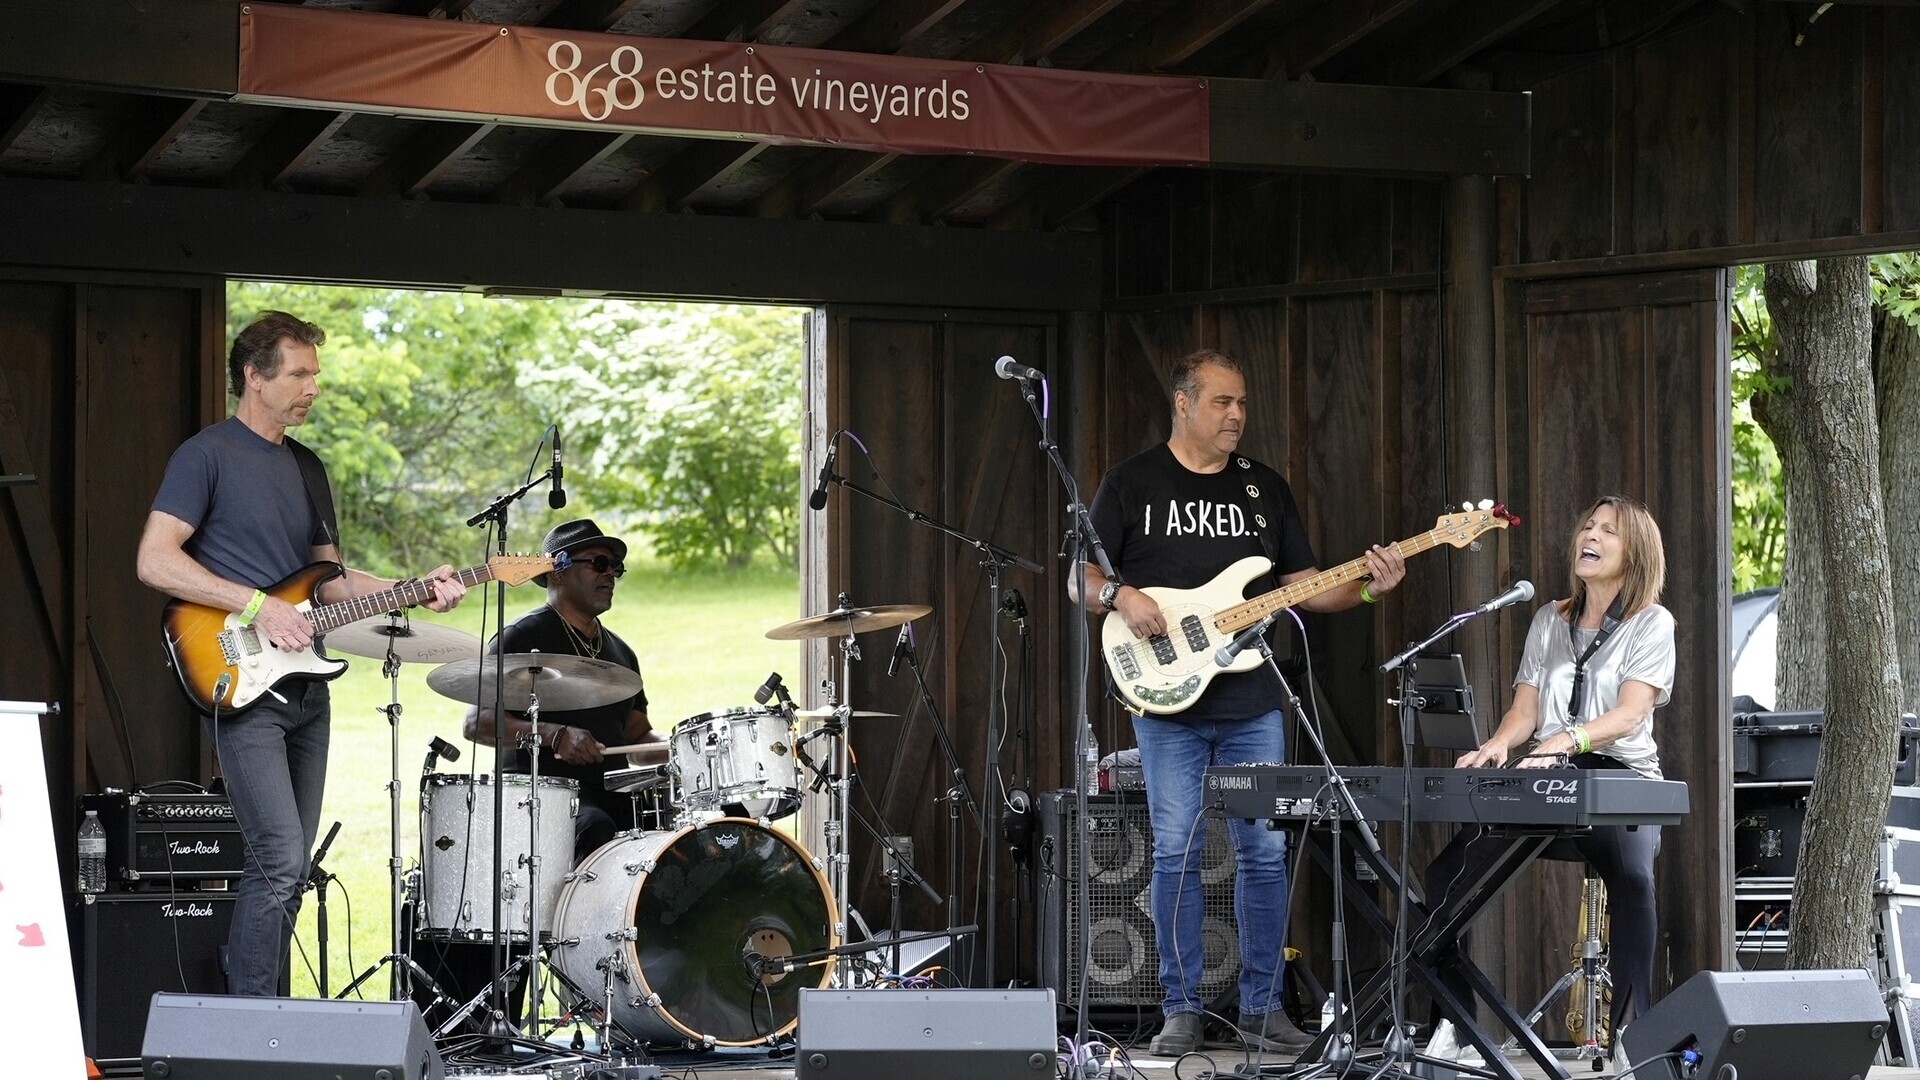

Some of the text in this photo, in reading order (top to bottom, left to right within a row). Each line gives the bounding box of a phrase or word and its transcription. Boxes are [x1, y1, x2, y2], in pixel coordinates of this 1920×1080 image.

[545, 40, 970, 124] 868 estate vineyards
[1144, 504, 1151, 536] I
[1219, 776, 1252, 790] YAMAHA
[1532, 779, 1578, 795] CP4
[1545, 796, 1578, 804] STAGE
[169, 840, 221, 855] Two-Rock
[161, 902, 214, 918] Two-Rock
